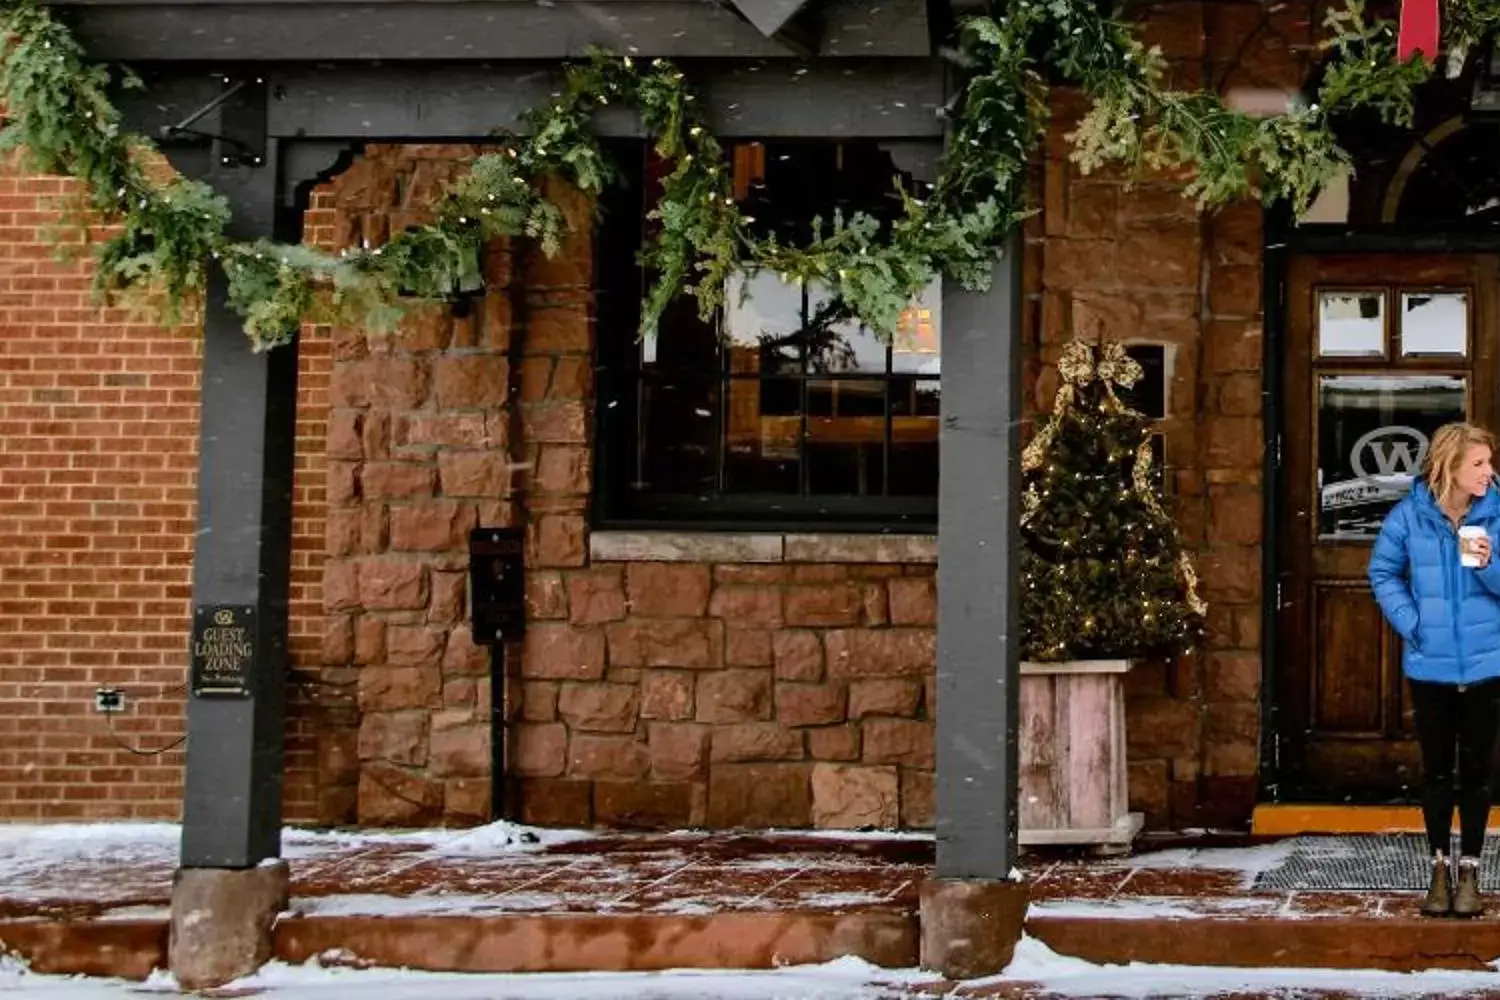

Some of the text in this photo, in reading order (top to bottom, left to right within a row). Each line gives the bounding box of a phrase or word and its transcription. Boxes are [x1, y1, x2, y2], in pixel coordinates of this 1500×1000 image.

[203, 627, 245, 641] GUEST
[195, 641, 252, 657] LOADING
[205, 656, 241, 671] ZONE
